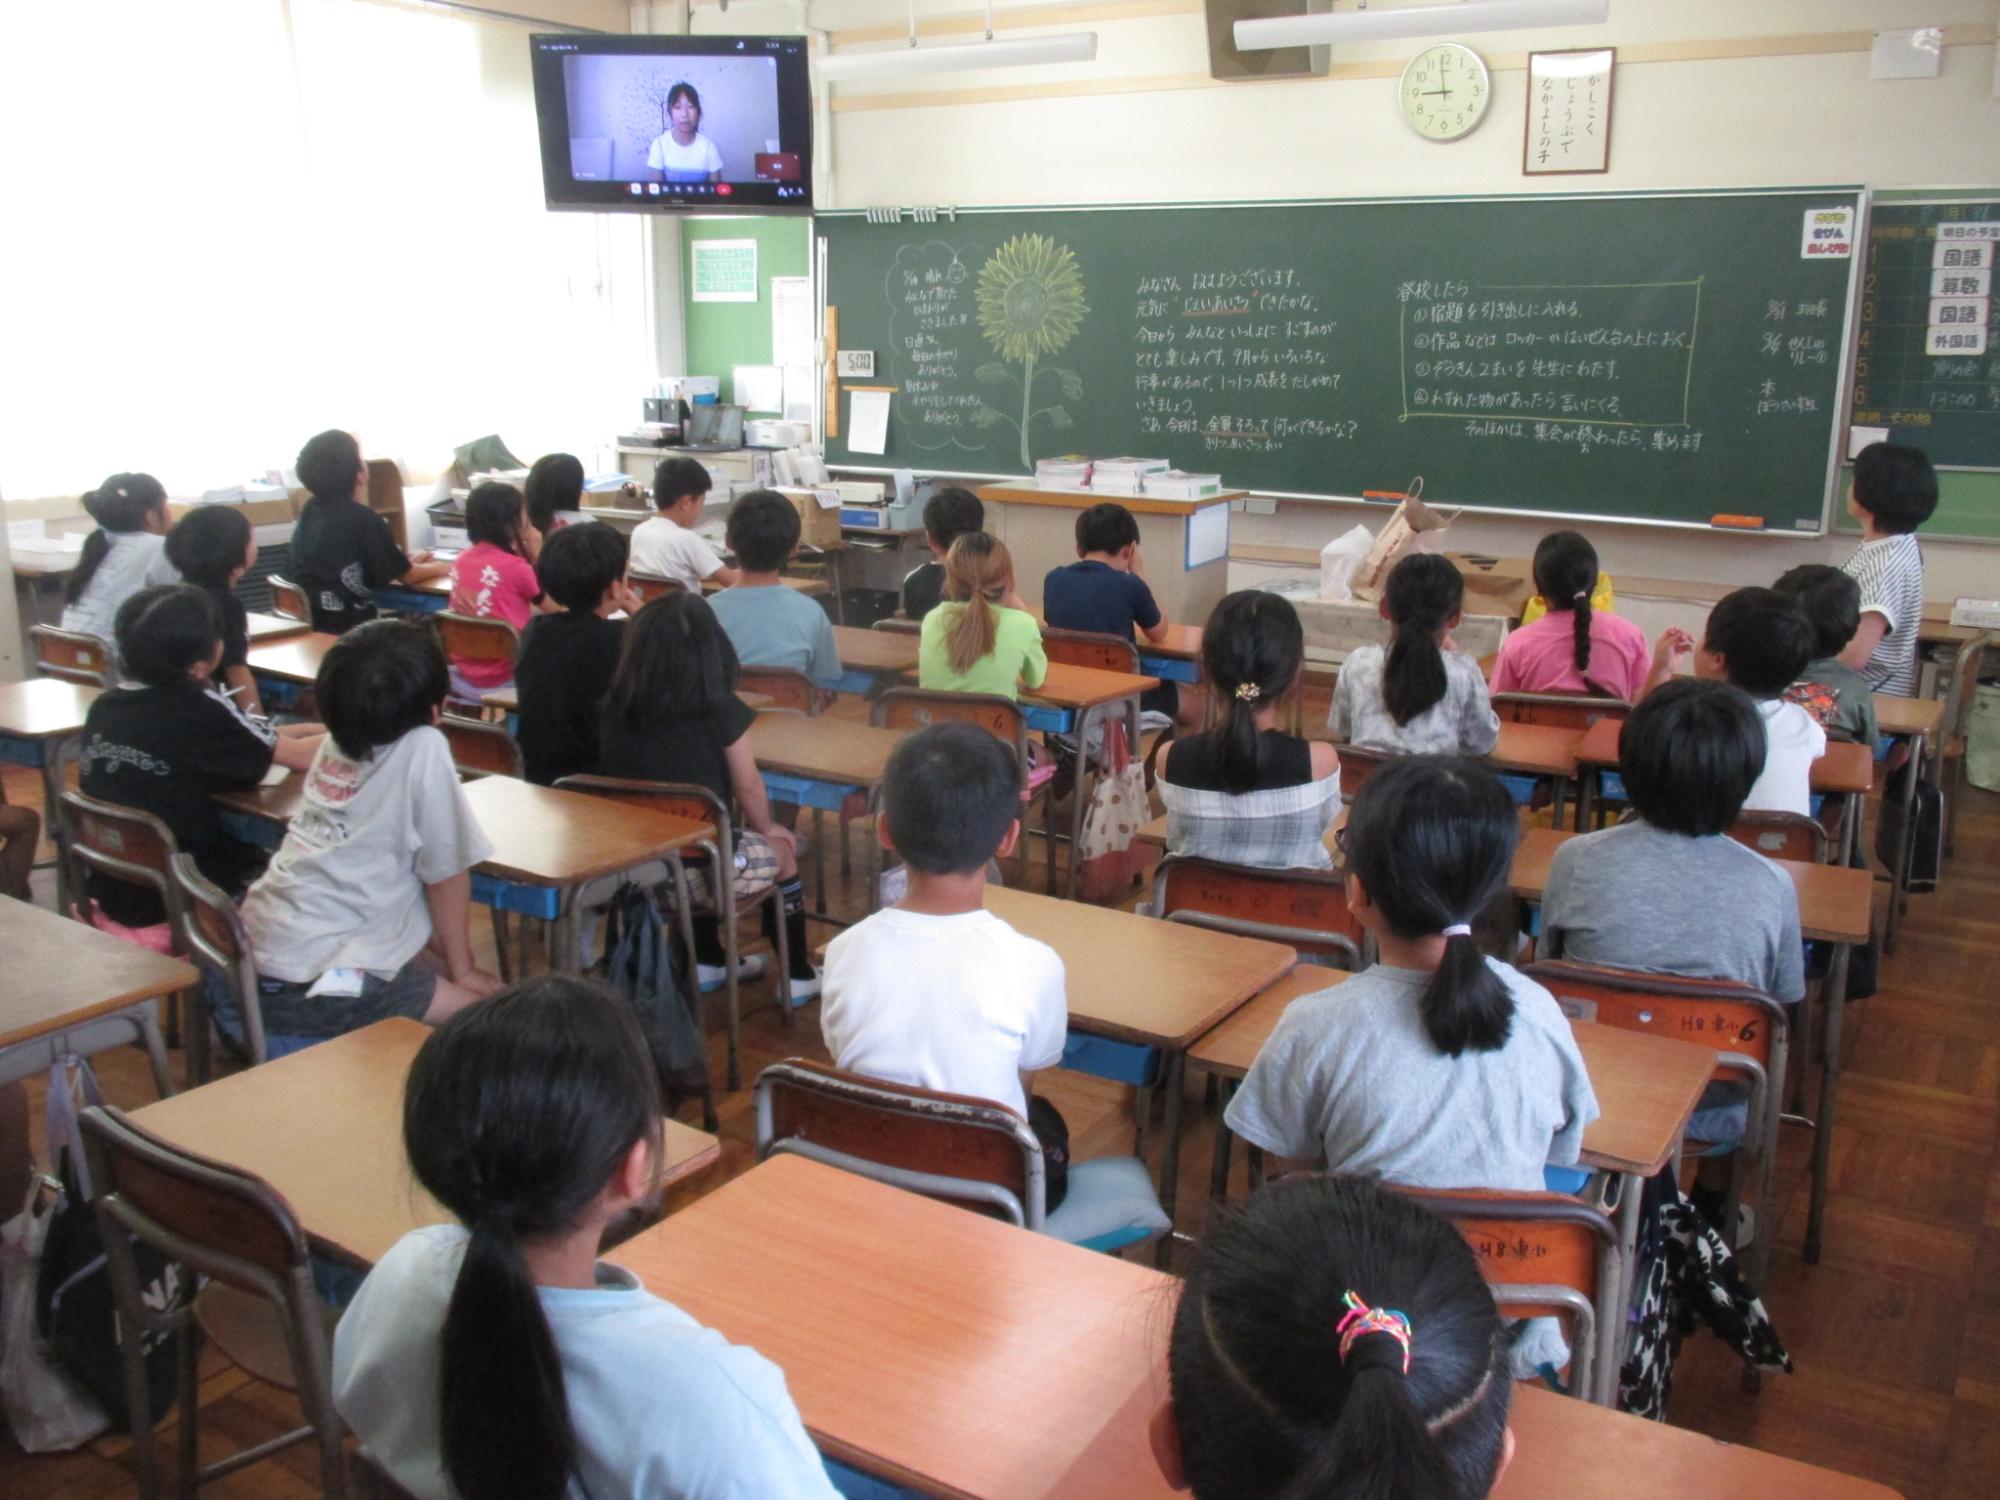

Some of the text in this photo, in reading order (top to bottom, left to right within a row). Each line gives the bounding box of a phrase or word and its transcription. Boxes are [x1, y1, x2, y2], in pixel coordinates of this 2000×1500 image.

[1426, 59, 1435, 71] 11
[1468, 68, 1476, 80] 2
[1416, 71, 1427, 83] 10
[1412, 87, 1420, 99] 9
[1472, 85, 1480, 97] 3
[1416, 103, 1424, 115] 8
[1467, 103, 1473, 112] 4
[1586, 75, 1600, 136] かしこく
[1427, 114, 1435, 126] 7
[1440, 119, 1448, 130] 6
[1456, 113, 1463, 125] 5
[1537, 77, 1554, 164] なかよしの子
[1560, 77, 1575, 154] じょうぶで
[1943, 226, 2000, 238] 明日の予定
[1943, 248, 1983, 267] 国語
[1136, 276, 1181, 294] みなさん
[1397, 280, 1469, 302] 登校したら
[1864, 273, 1877, 294] 2
[1941, 276, 1981, 295] 算数
[1861, 303, 1874, 322] 3
[1938, 305, 1979, 324] 国語
[1858, 330, 1870, 350] 4
[1934, 334, 1980, 349] 外国語
[1856, 357, 1868, 377] 5
[1760, 379, 1776, 397] 木
[1854, 385, 1865, 404] 6
[1739, 1019, 1759, 1042] 6
